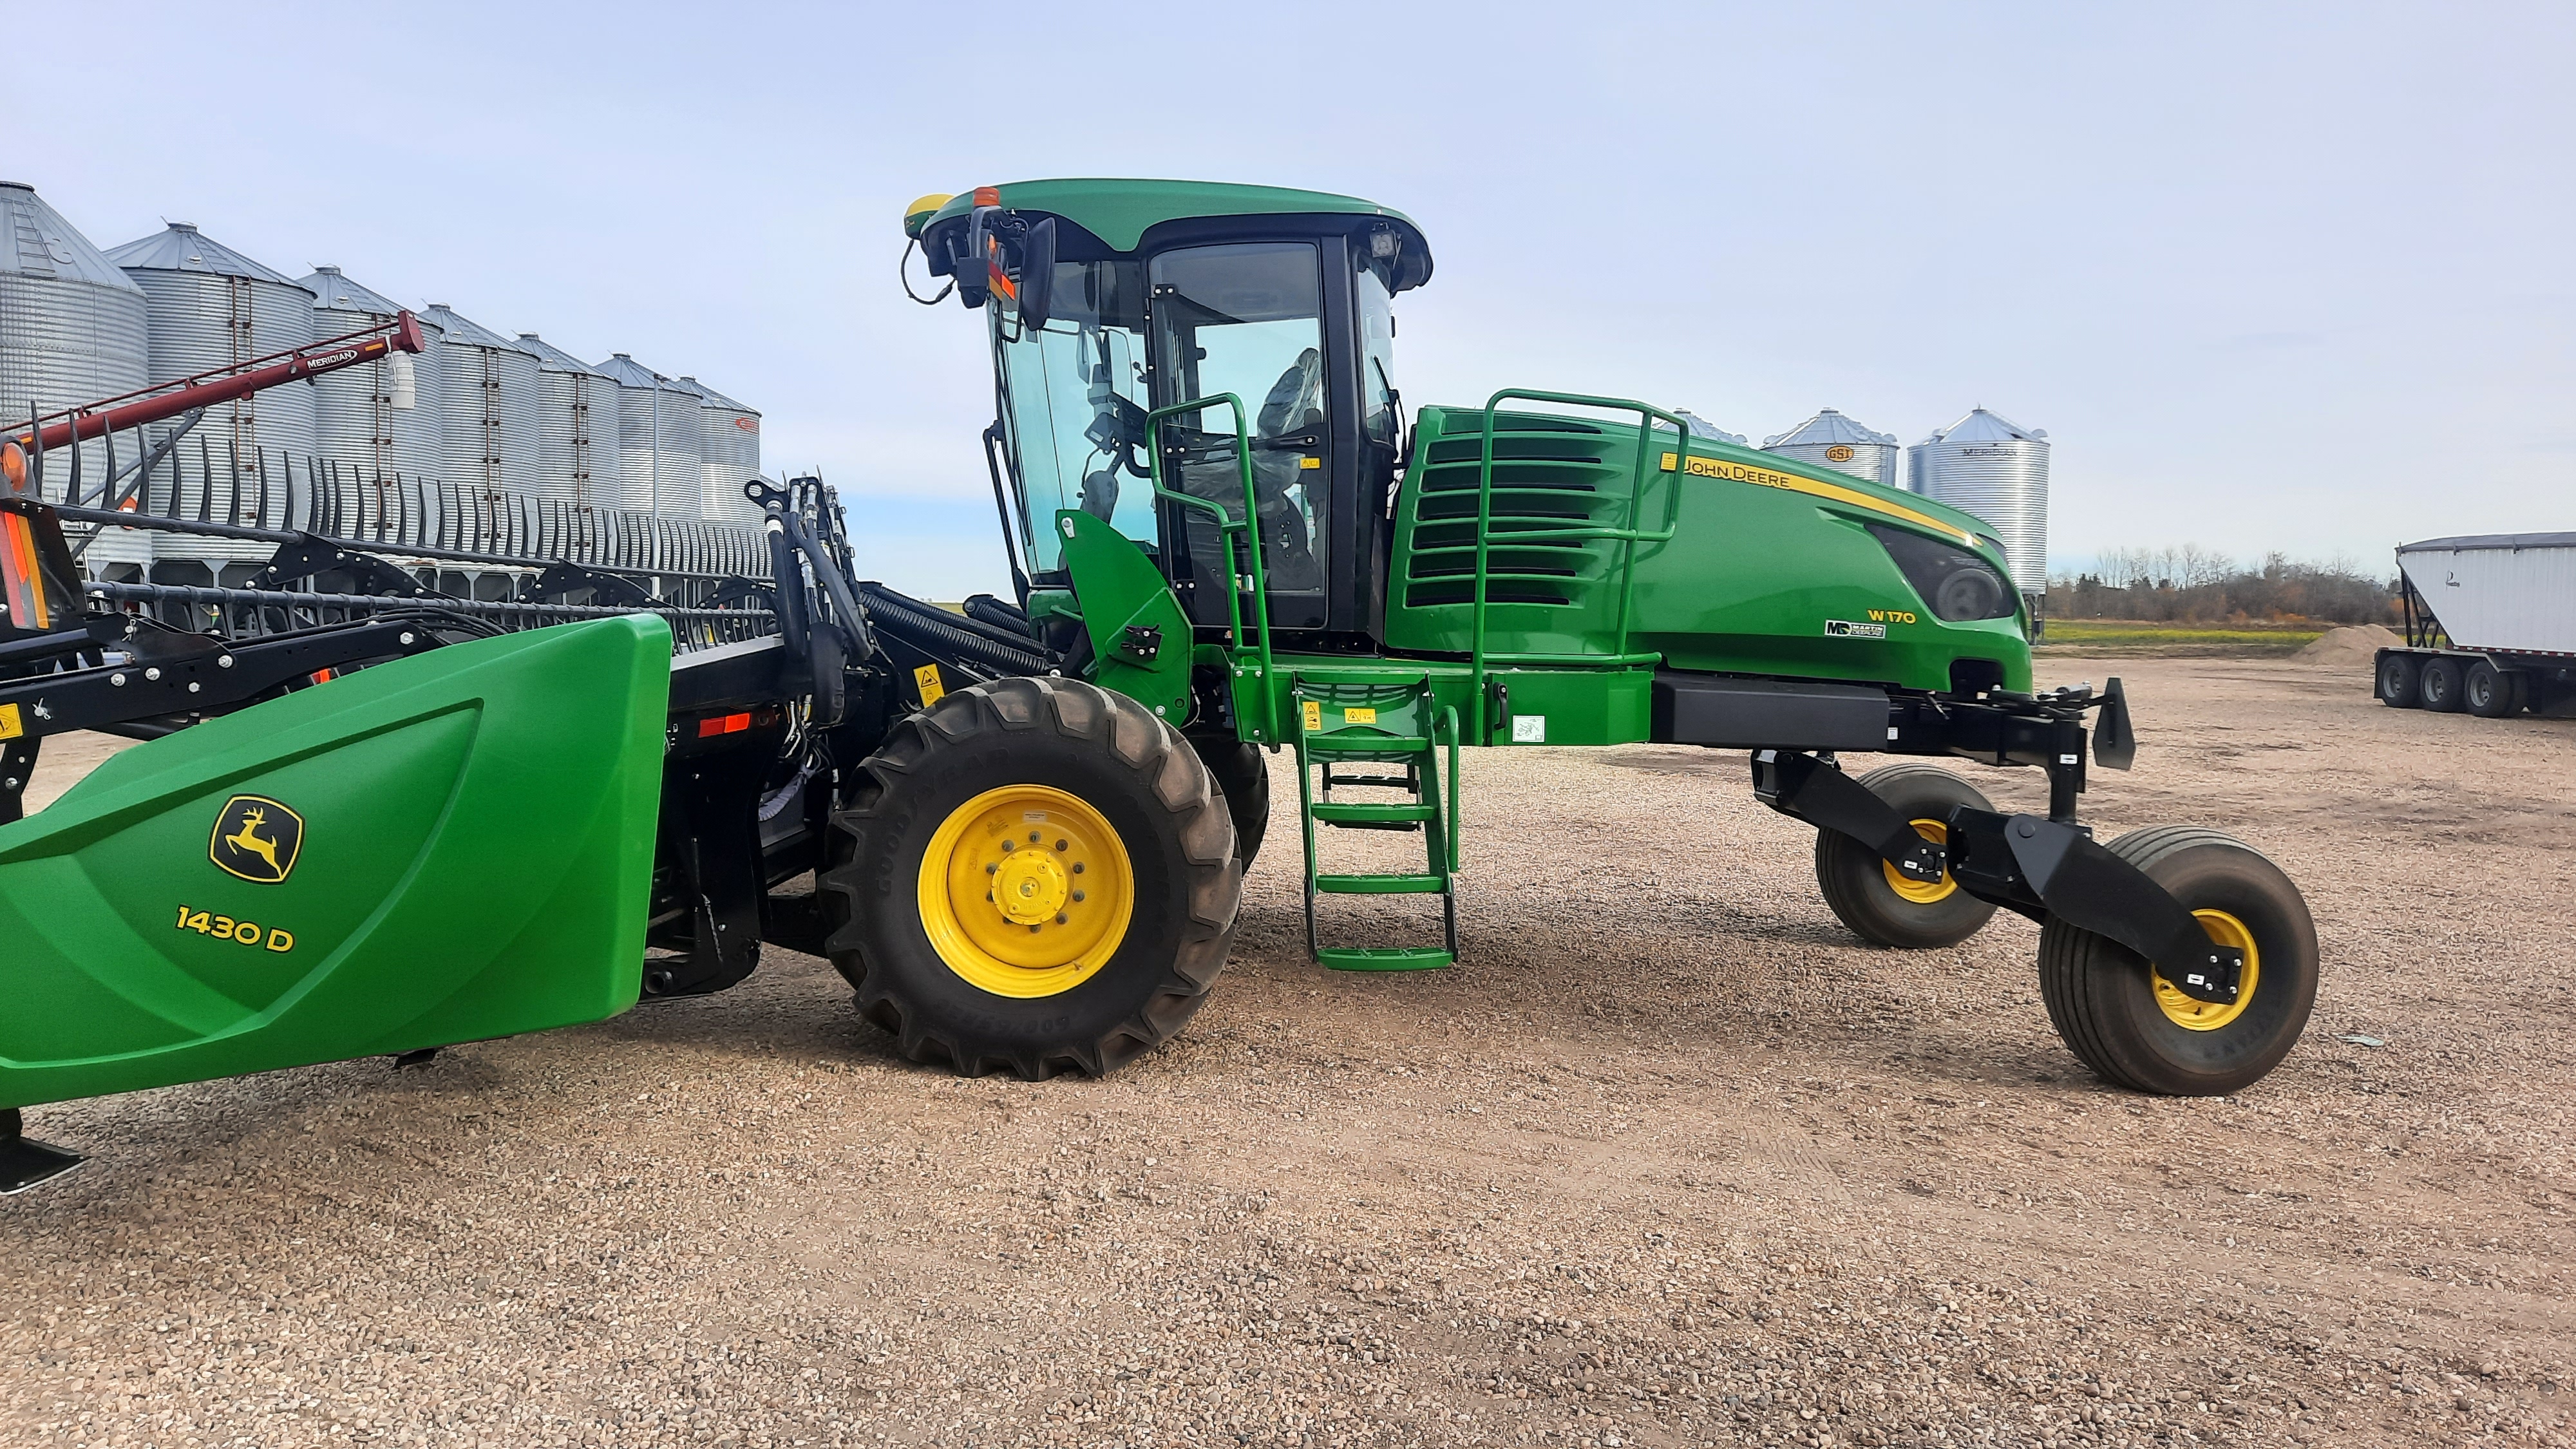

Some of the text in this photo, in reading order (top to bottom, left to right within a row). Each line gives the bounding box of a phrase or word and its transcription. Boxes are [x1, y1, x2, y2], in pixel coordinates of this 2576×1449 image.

[307, 352, 352, 369] MERIDIAN
[1829, 448, 1850, 459] GSI
[1684, 459, 1790, 488] JOHN DEERE
[1867, 609, 1917, 625] W 170
[876, 747, 1011, 893] GOODYEAR
[176, 905, 294, 952] 1430 D
